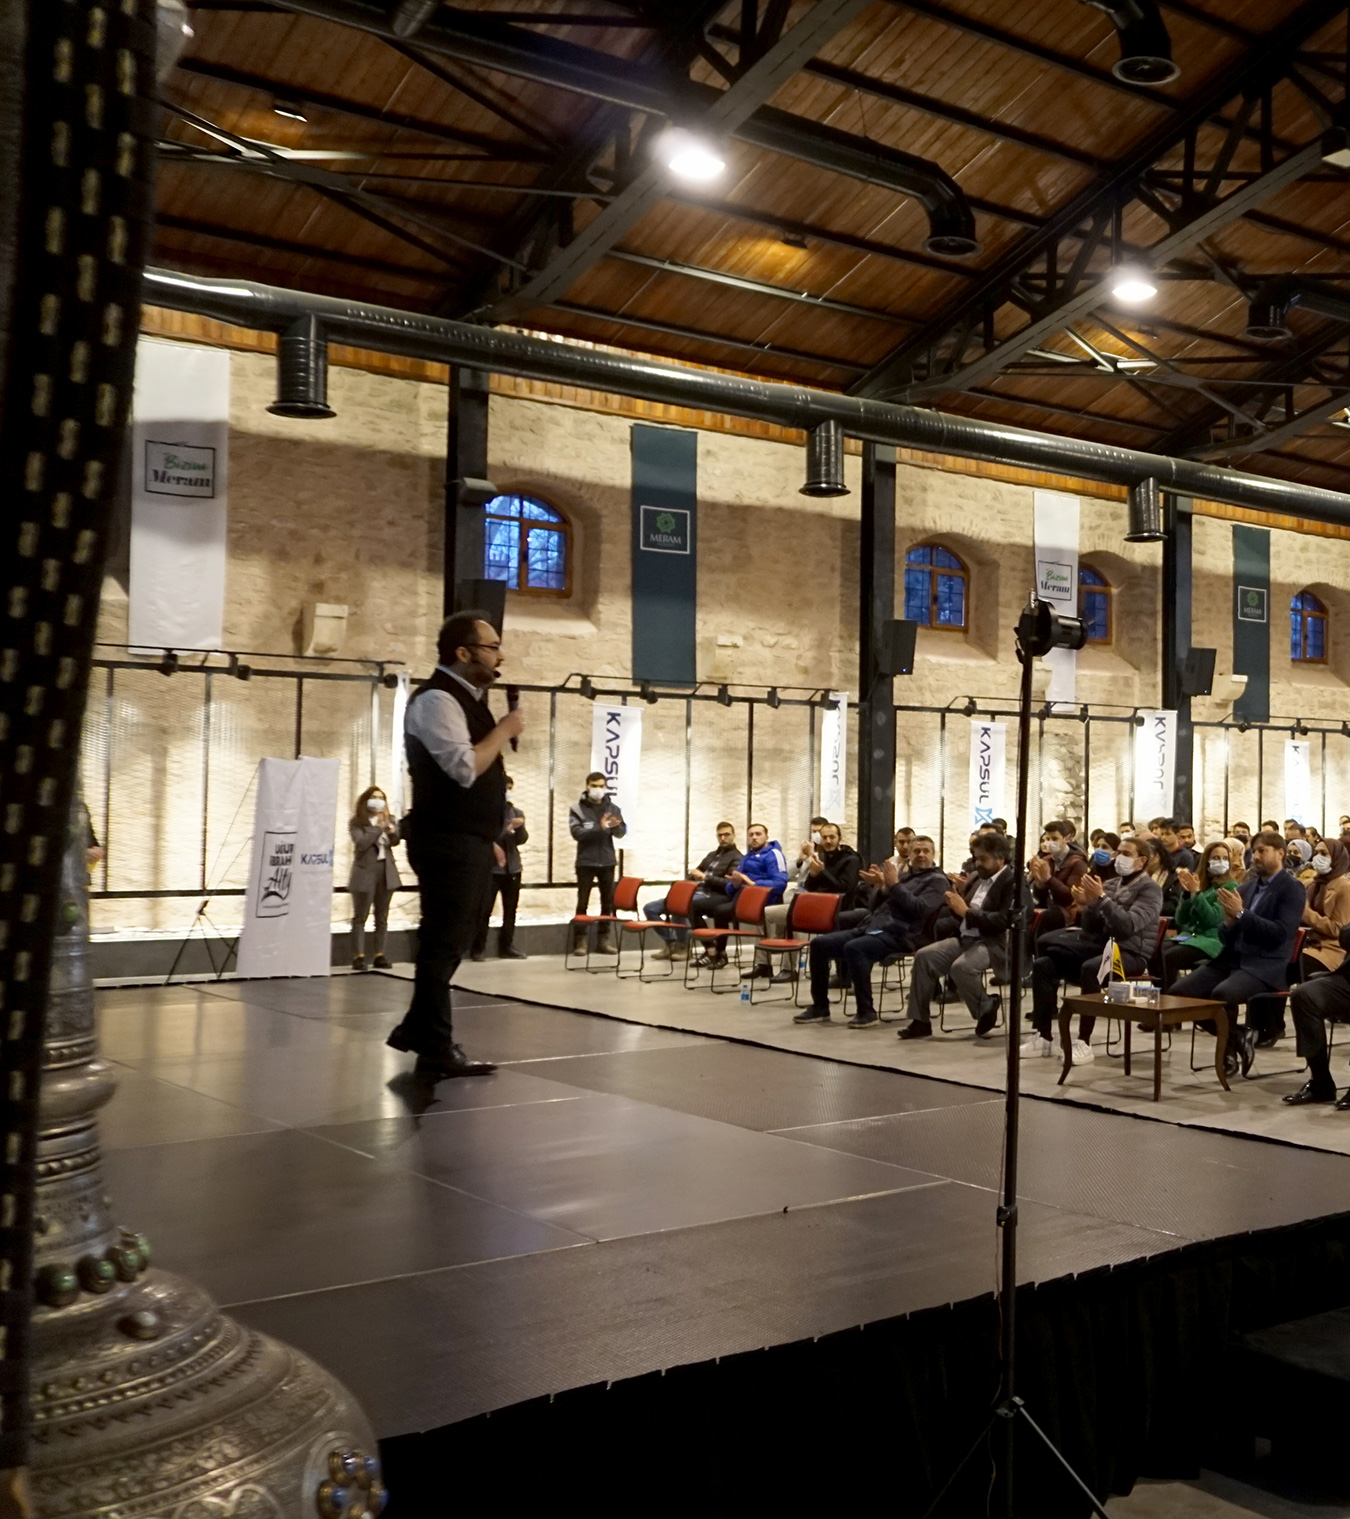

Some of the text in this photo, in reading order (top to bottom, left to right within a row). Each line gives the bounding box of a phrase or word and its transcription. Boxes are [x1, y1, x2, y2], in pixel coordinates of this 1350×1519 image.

[152, 469, 211, 488] Meram
[650, 533, 682, 544] MERAM
[979, 727, 991, 804] KAPSUL
[301, 853, 329, 865] KAPSUL
